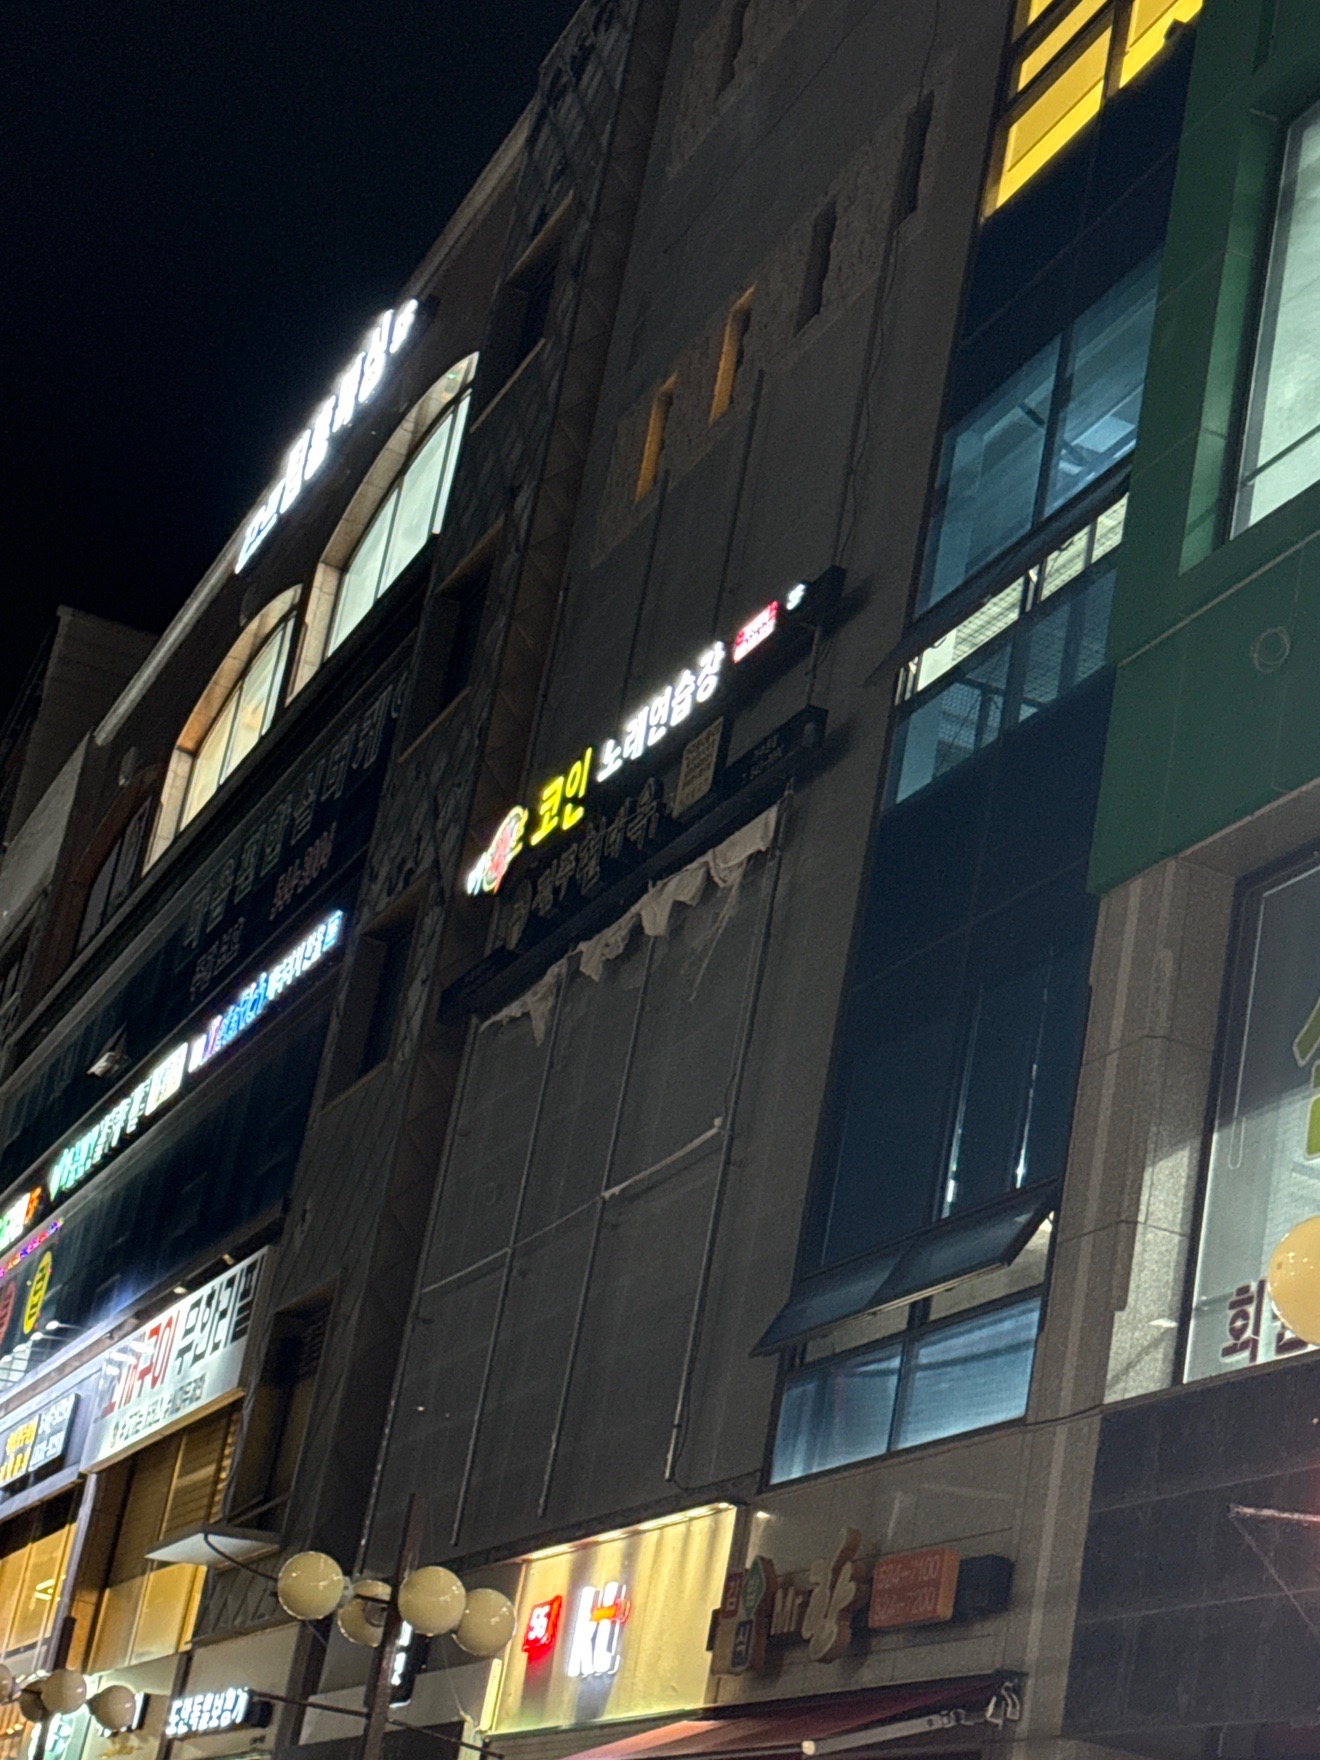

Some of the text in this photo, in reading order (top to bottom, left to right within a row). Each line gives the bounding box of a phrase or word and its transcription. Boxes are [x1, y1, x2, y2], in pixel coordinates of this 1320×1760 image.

[530, 746, 594, 847] 코인
[596, 640, 726, 783] 노래연습장
[175, 1254, 264, 1375] 무한리필
